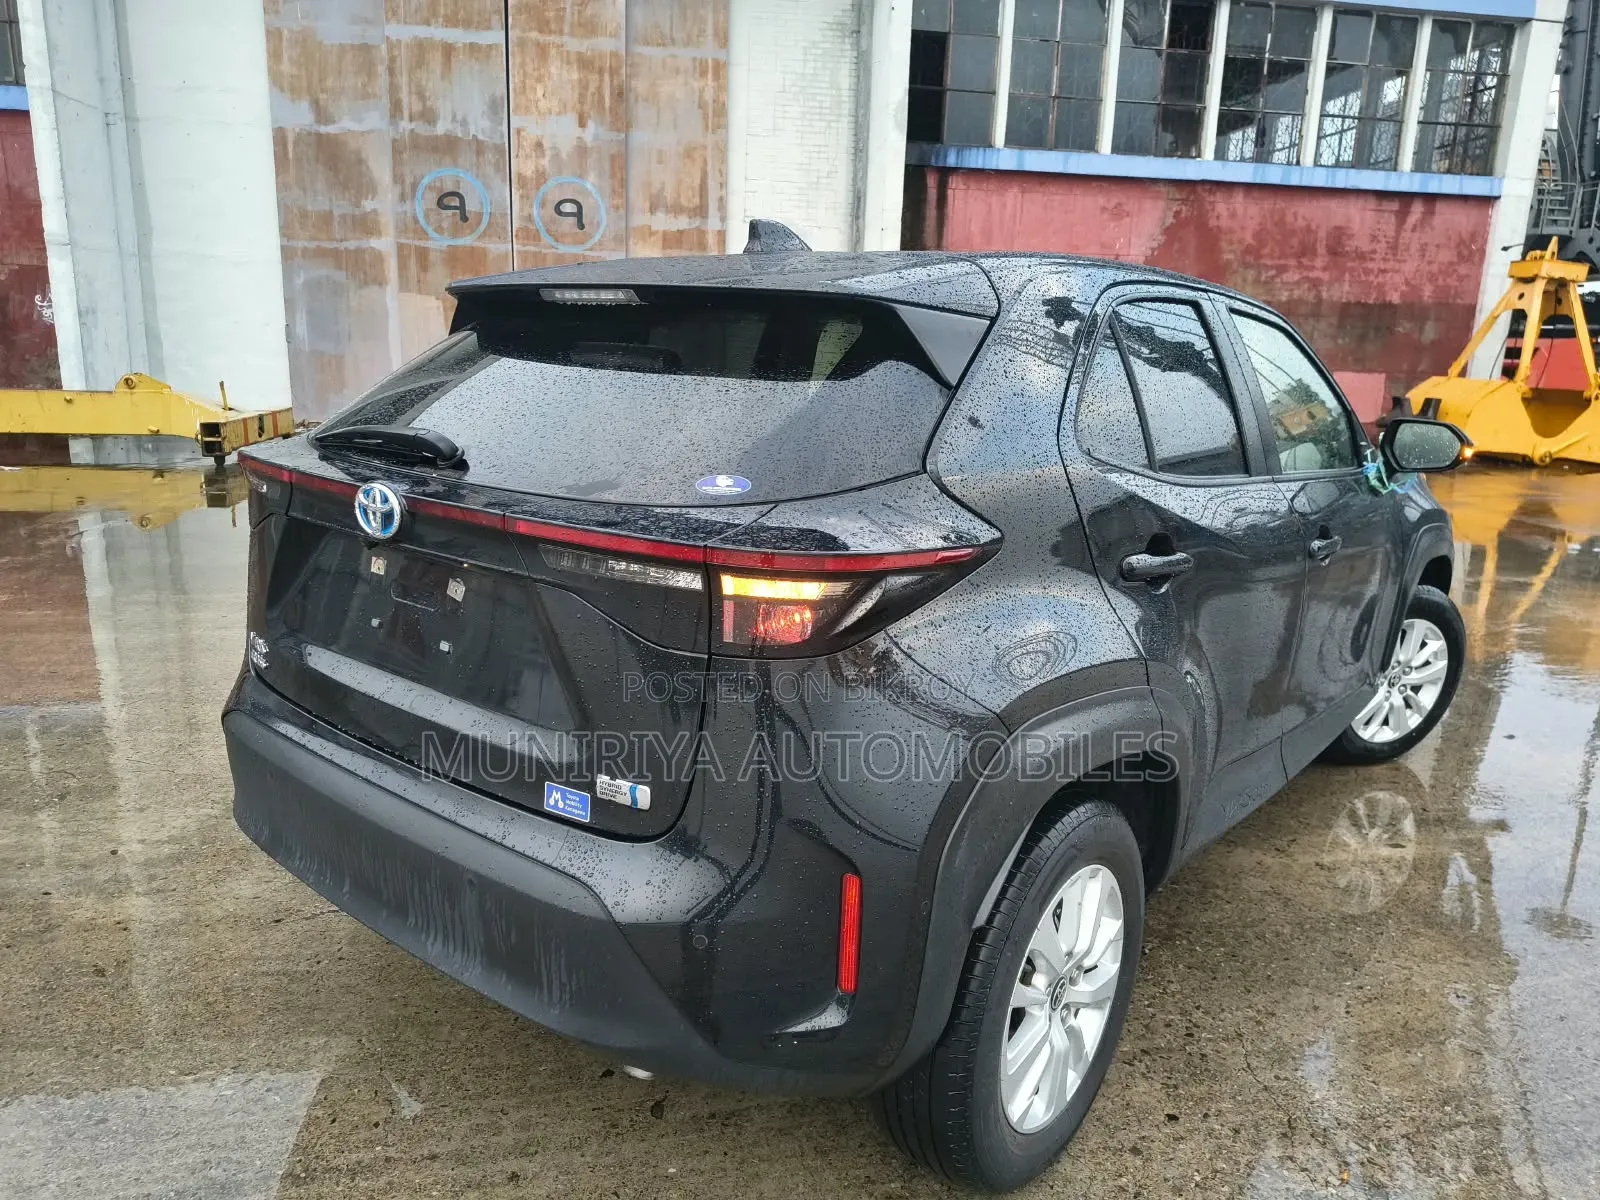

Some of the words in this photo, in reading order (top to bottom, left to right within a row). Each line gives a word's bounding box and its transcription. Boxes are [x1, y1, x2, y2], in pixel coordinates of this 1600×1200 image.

[600, 780, 622, 790] HYBRID
[600, 785, 628, 797] SYNERGY
[600, 791, 618, 799] DRIVE
[566, 792, 580, 801] Toyota
